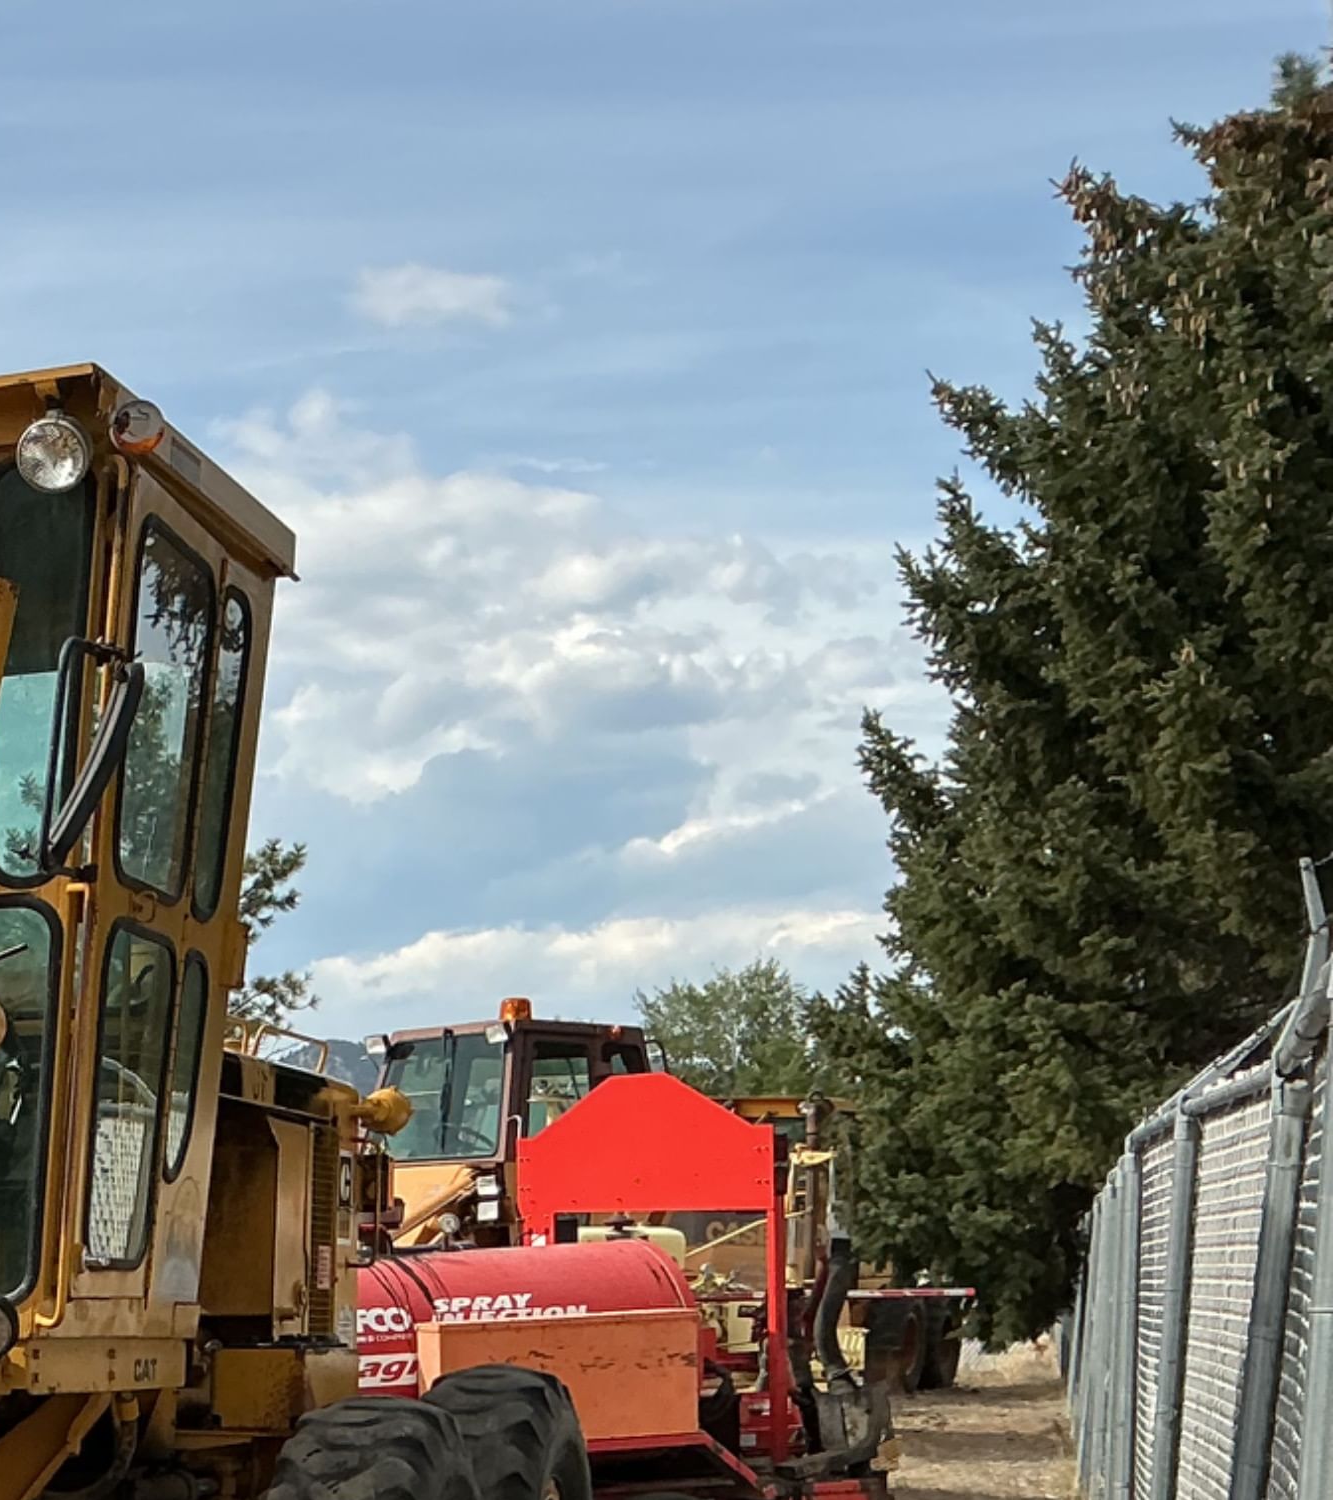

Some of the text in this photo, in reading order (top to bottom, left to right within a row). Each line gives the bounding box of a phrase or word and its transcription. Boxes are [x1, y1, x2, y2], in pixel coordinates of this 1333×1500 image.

[433, 1293, 533, 1313] SPRAY
[356, 1306, 413, 1334] FCO
[133, 1357, 157, 1382] CAT
